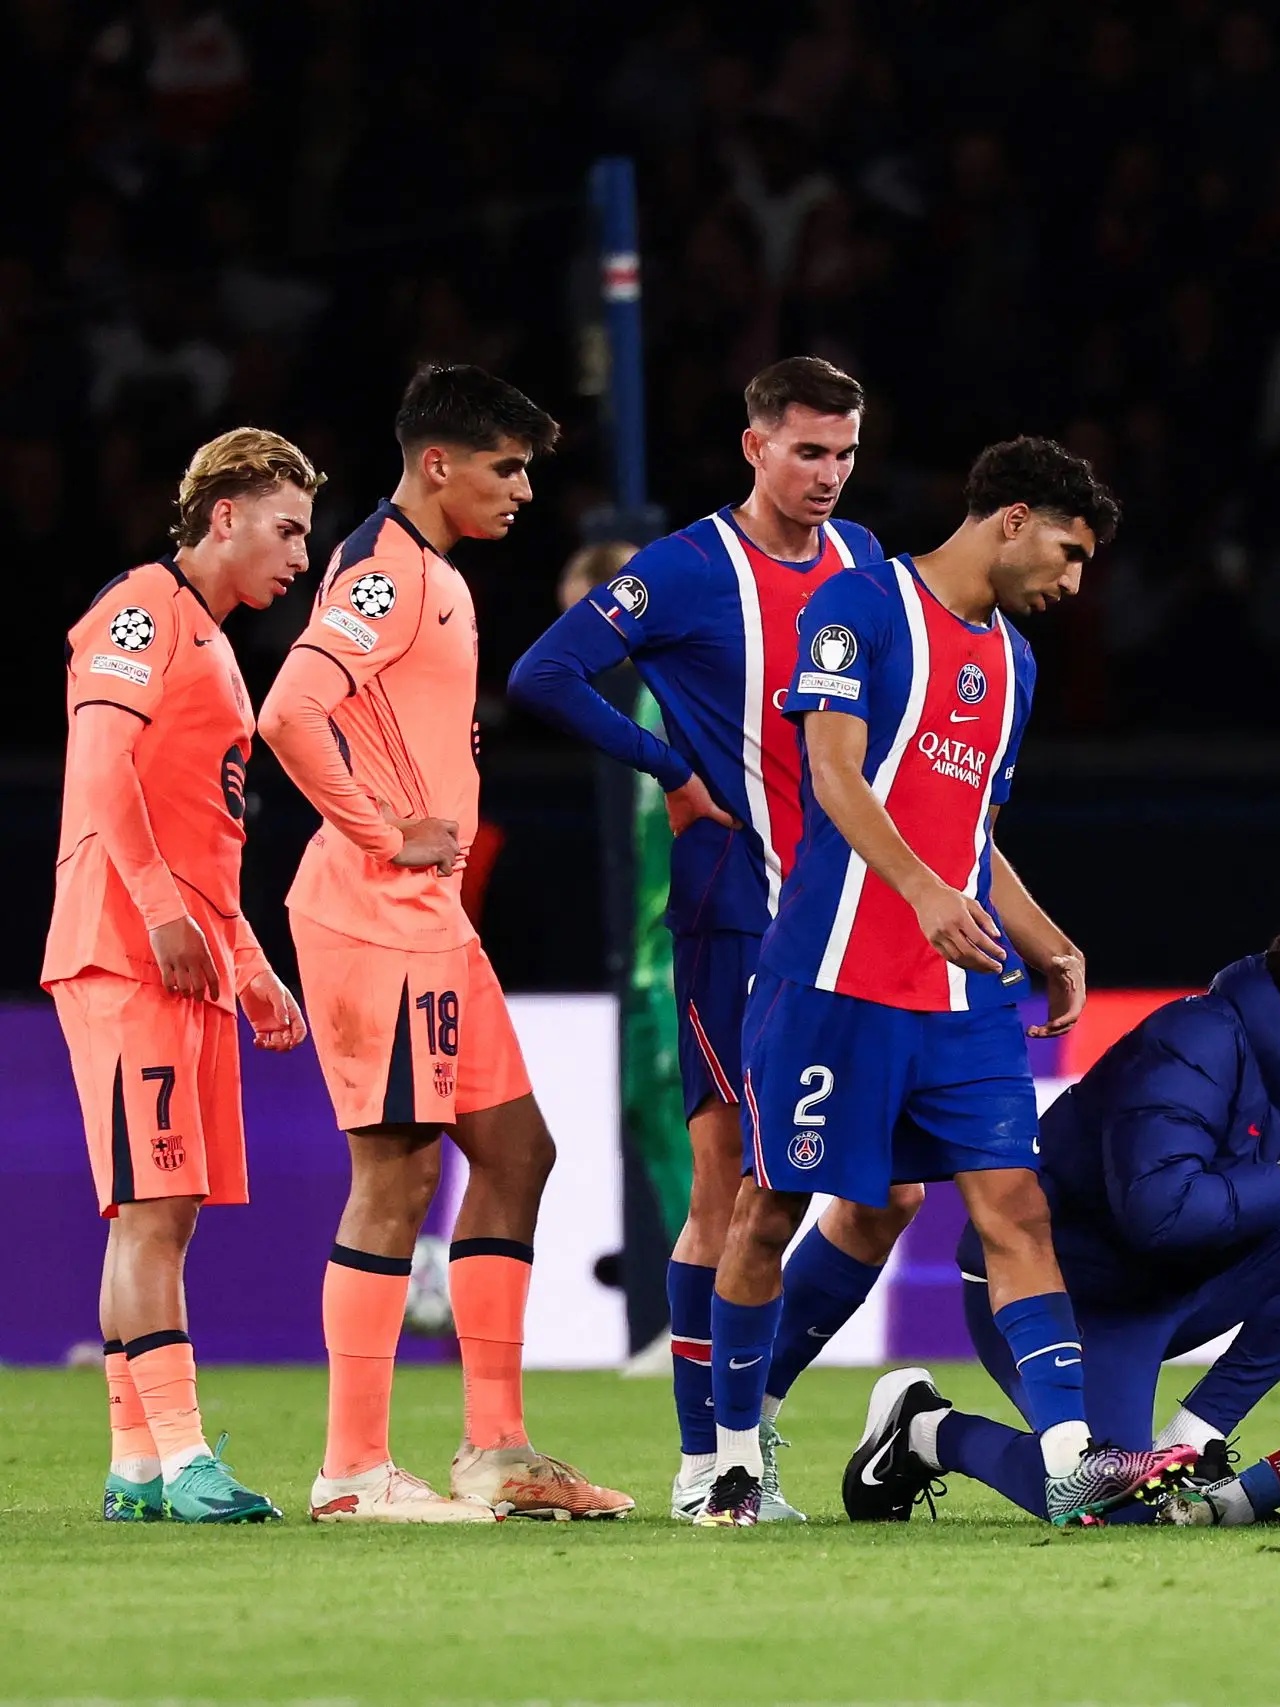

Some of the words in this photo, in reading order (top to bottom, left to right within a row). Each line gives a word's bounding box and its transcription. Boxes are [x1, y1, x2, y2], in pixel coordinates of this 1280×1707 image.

[328, 611, 374, 646] FOUNDATION
[93, 660, 149, 680] FOUNDATION
[801, 679, 858, 693] FOUNDATION
[918, 731, 986, 775] QATAR
[931, 758, 981, 789] AIRWAYS
[415, 990, 459, 1057] 18
[141, 1065, 175, 1131] 7
[793, 1064, 834, 1126] 2
[797, 1131, 820, 1142] PARIS
